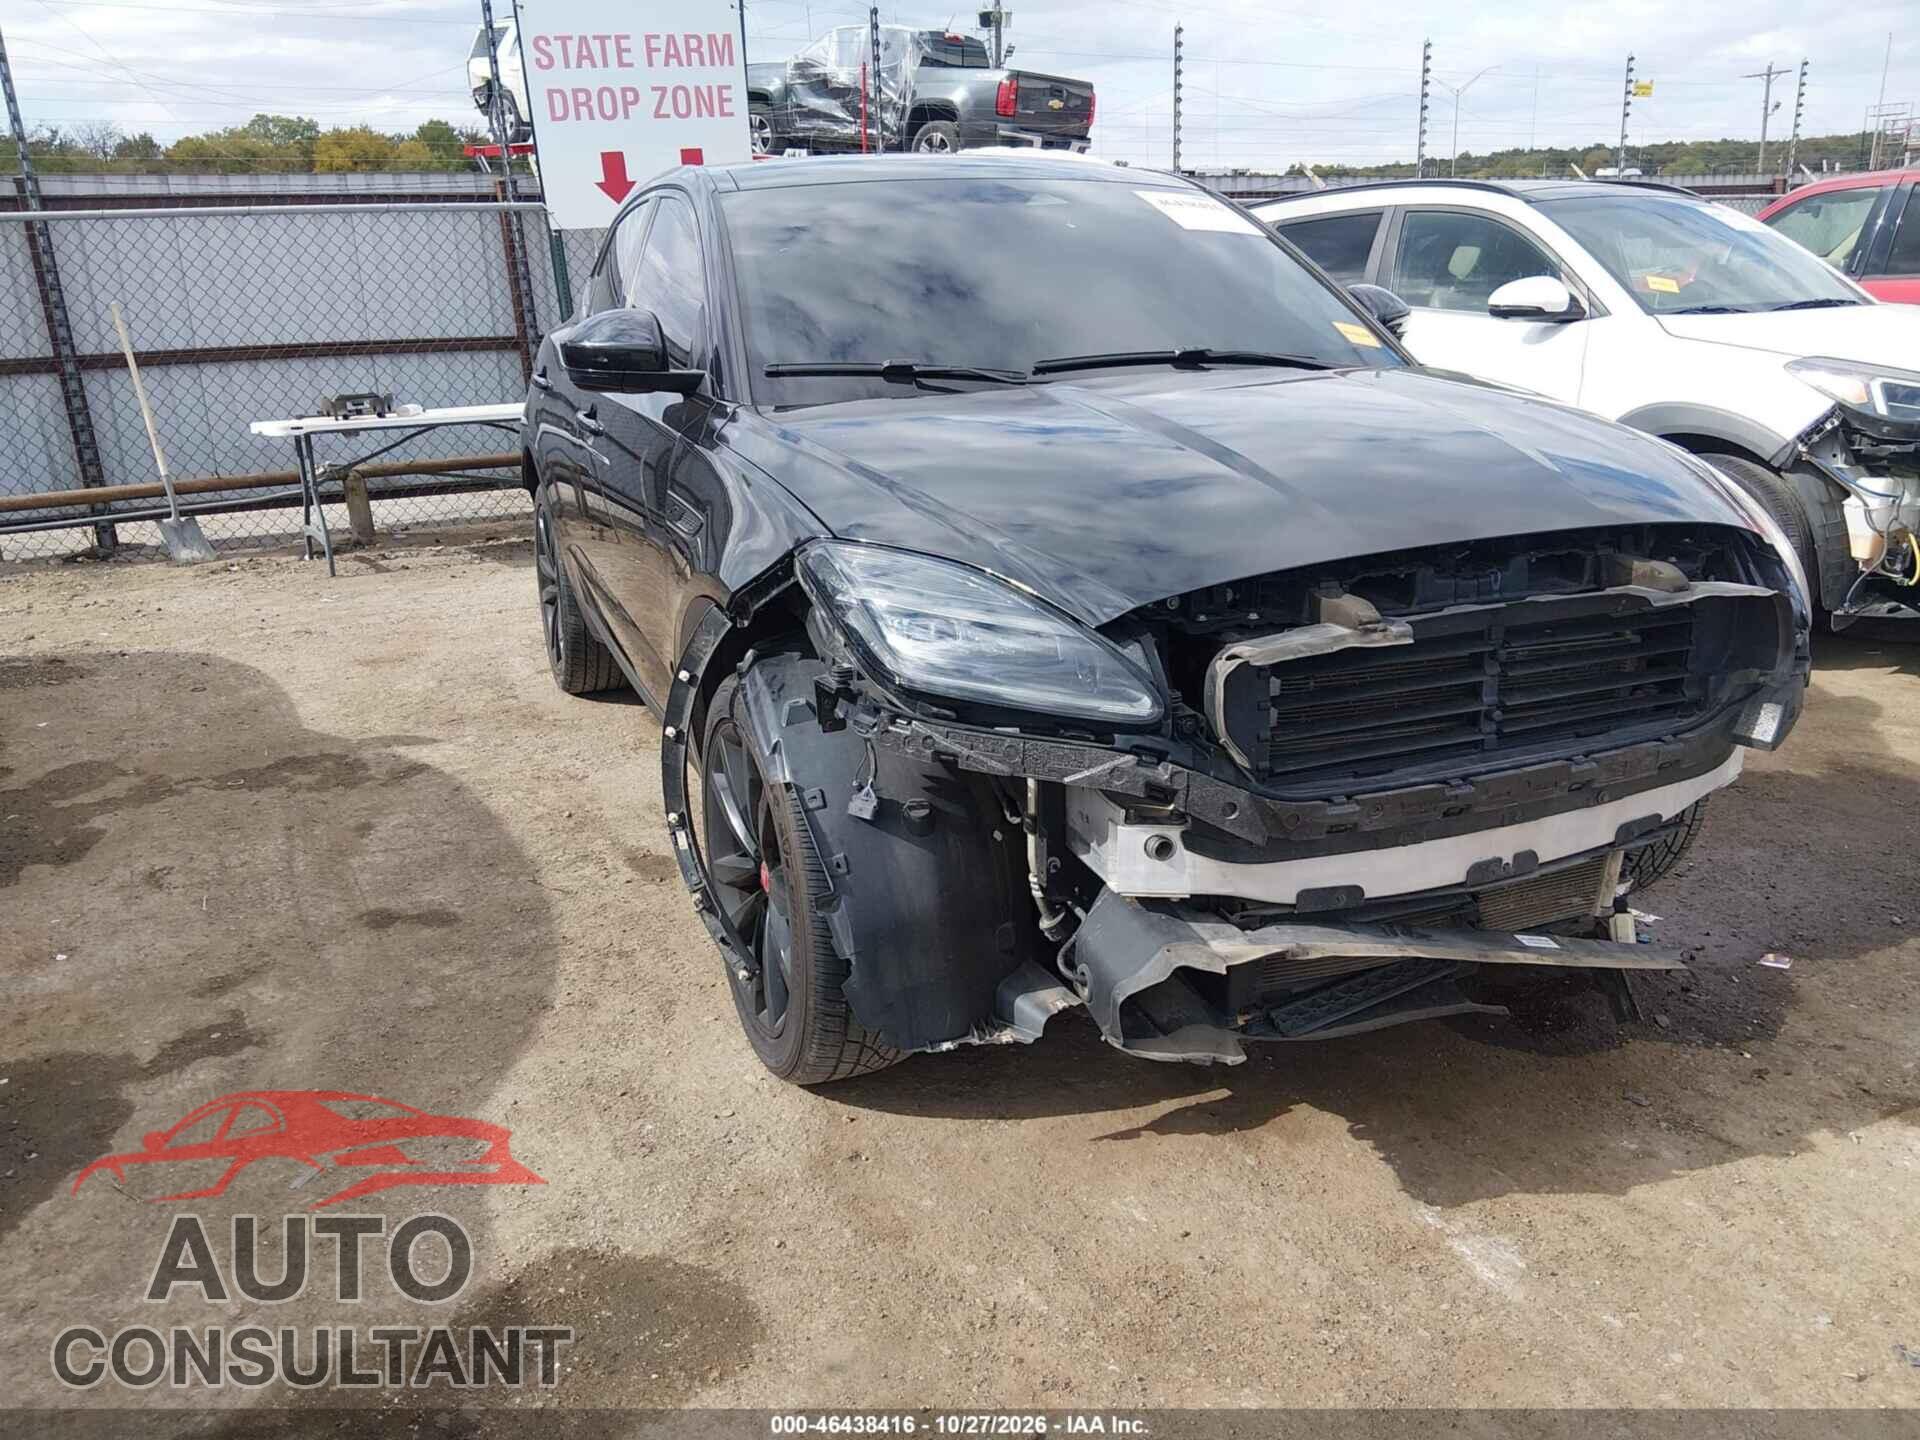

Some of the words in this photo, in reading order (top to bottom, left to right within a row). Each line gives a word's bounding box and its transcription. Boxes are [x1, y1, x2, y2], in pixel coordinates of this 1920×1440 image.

[532, 34, 635, 70] STATE
[643, 33, 735, 68] FARM
[546, 86, 640, 122] DROP
[650, 85, 735, 119] ZONE
